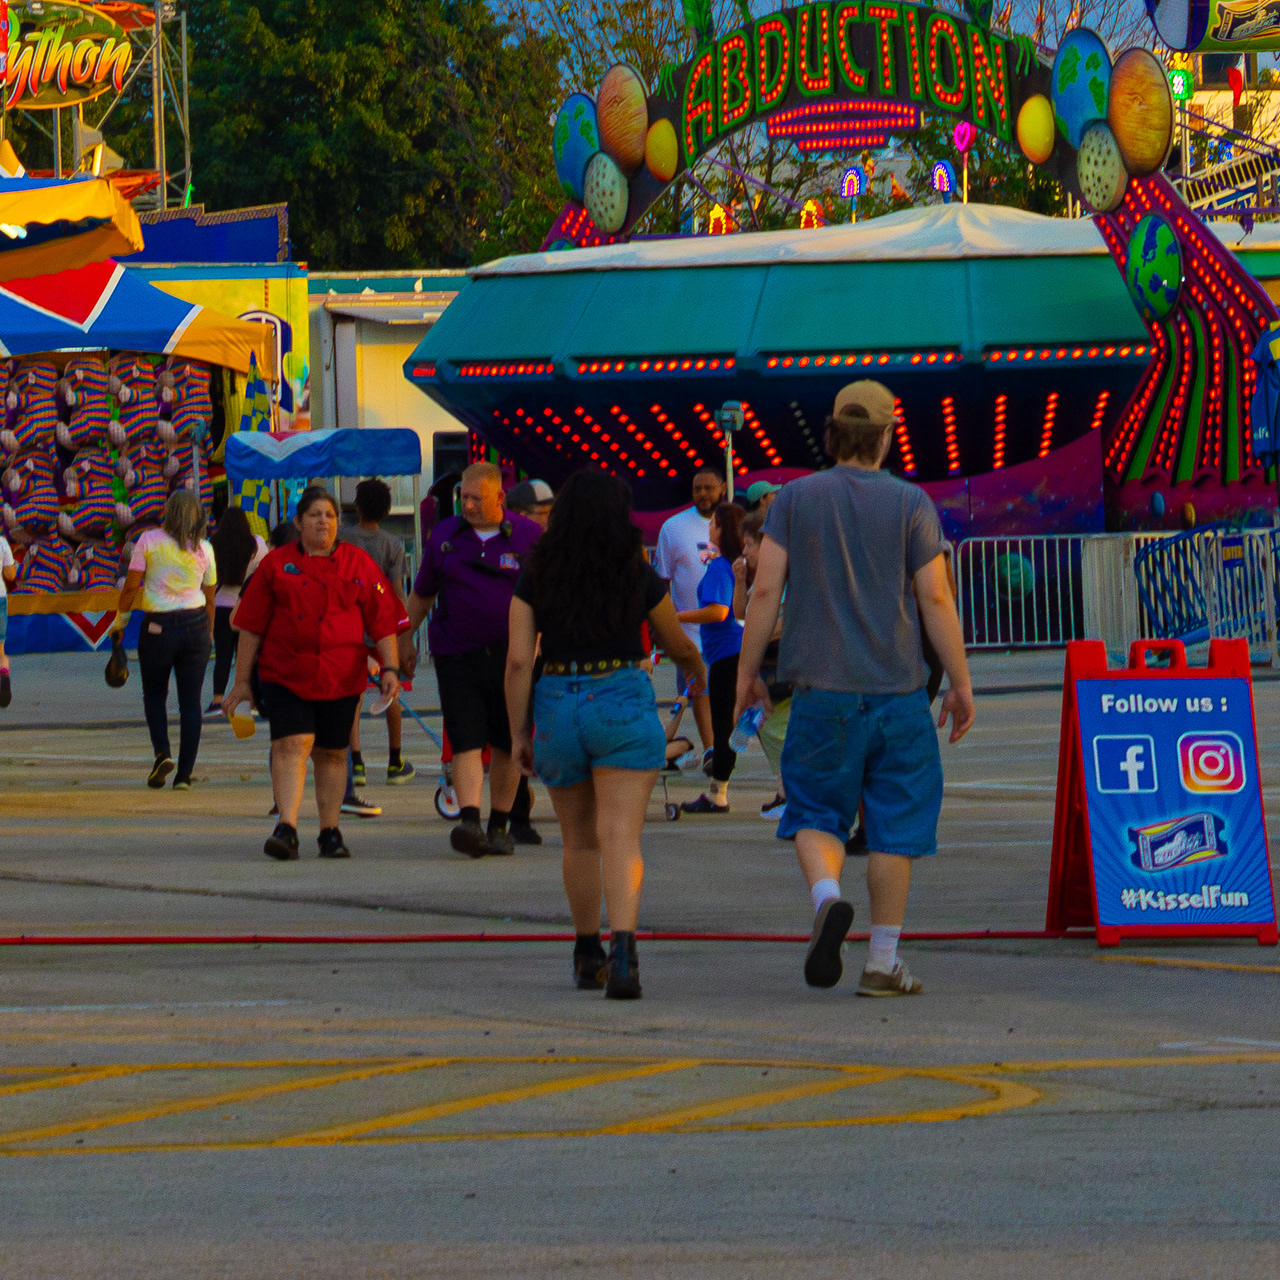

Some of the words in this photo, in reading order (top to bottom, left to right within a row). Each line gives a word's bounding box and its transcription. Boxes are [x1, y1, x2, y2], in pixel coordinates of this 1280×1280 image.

[682, 0, 1013, 168] ABDUCTION
[1101, 693, 1179, 714] Follow
[1185, 697, 1214, 713] us
[1120, 884, 1250, 912] #KisselFun
